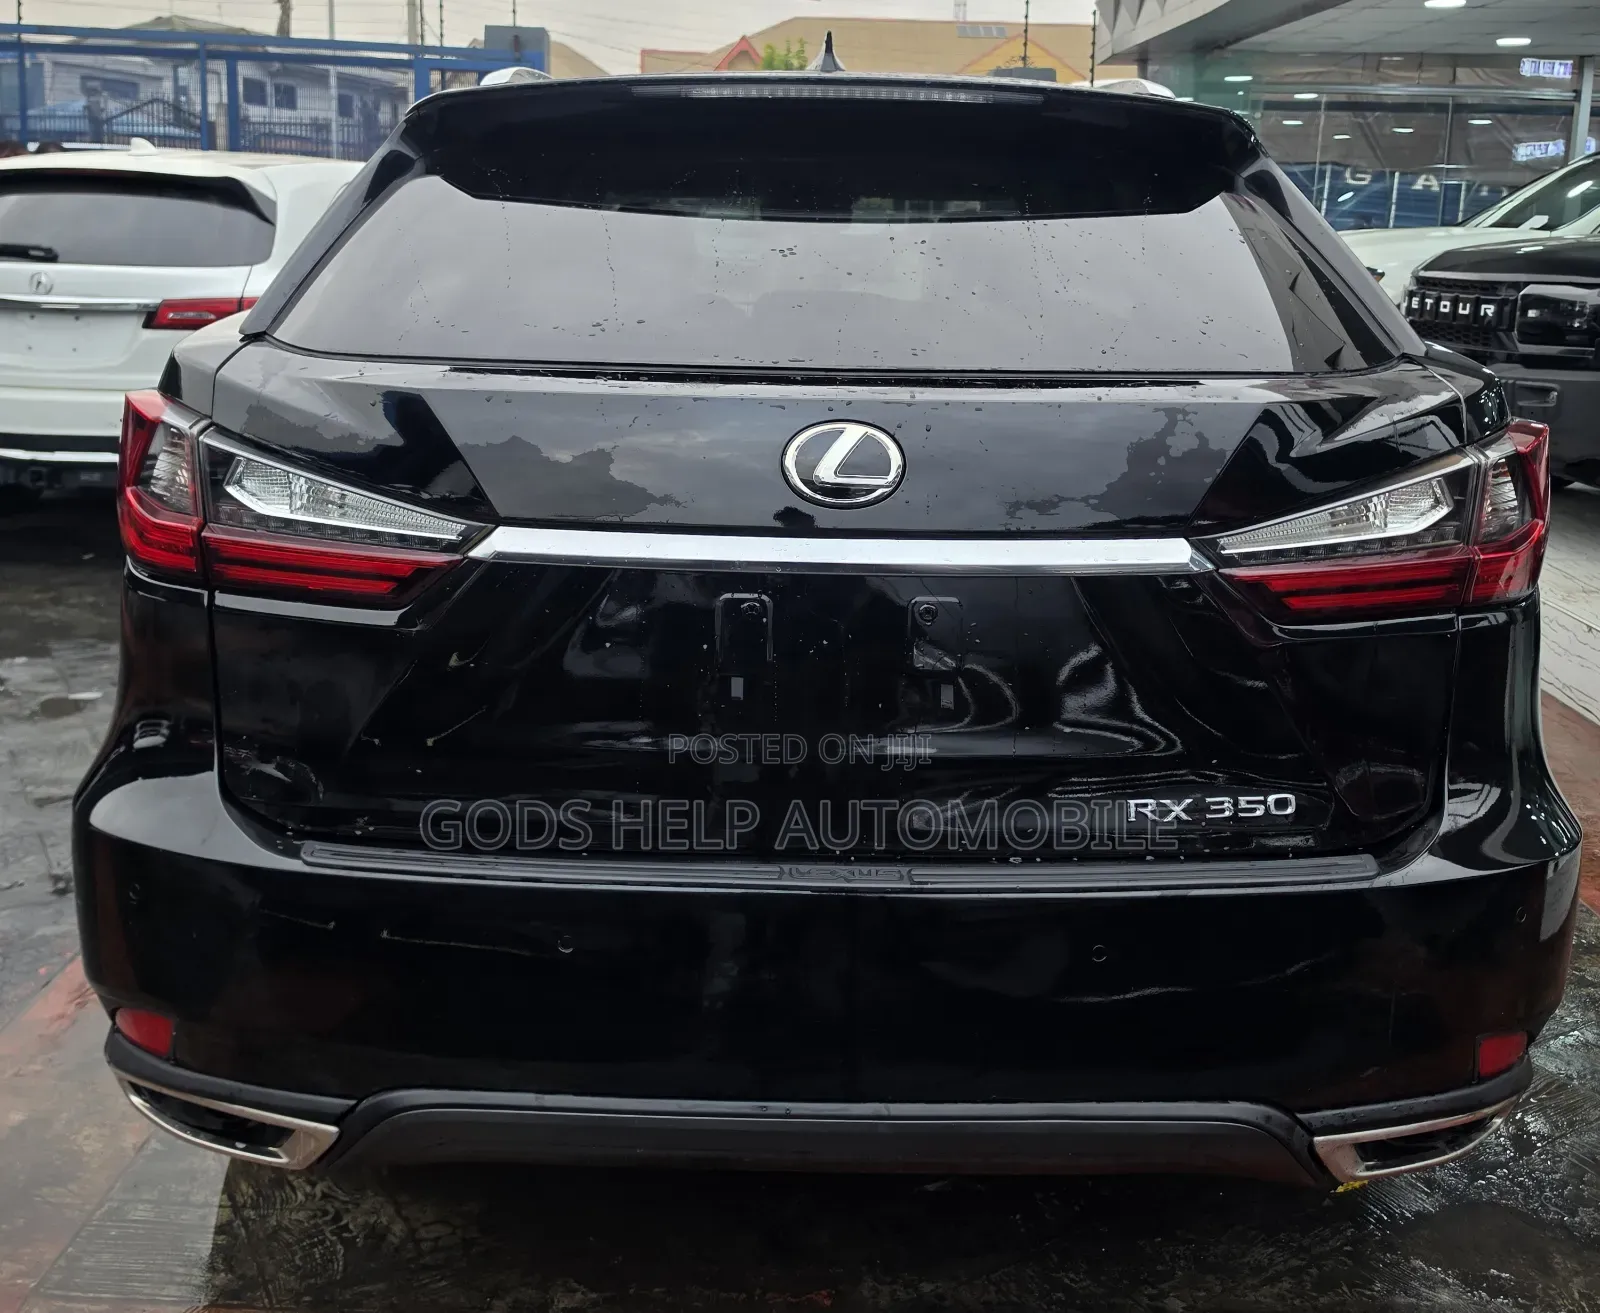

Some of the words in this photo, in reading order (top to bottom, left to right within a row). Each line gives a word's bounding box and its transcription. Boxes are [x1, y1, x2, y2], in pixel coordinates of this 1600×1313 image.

[1126, 798, 1194, 822] RX
[1205, 793, 1297, 818] 350
[787, 867, 904, 882] LEXUS
